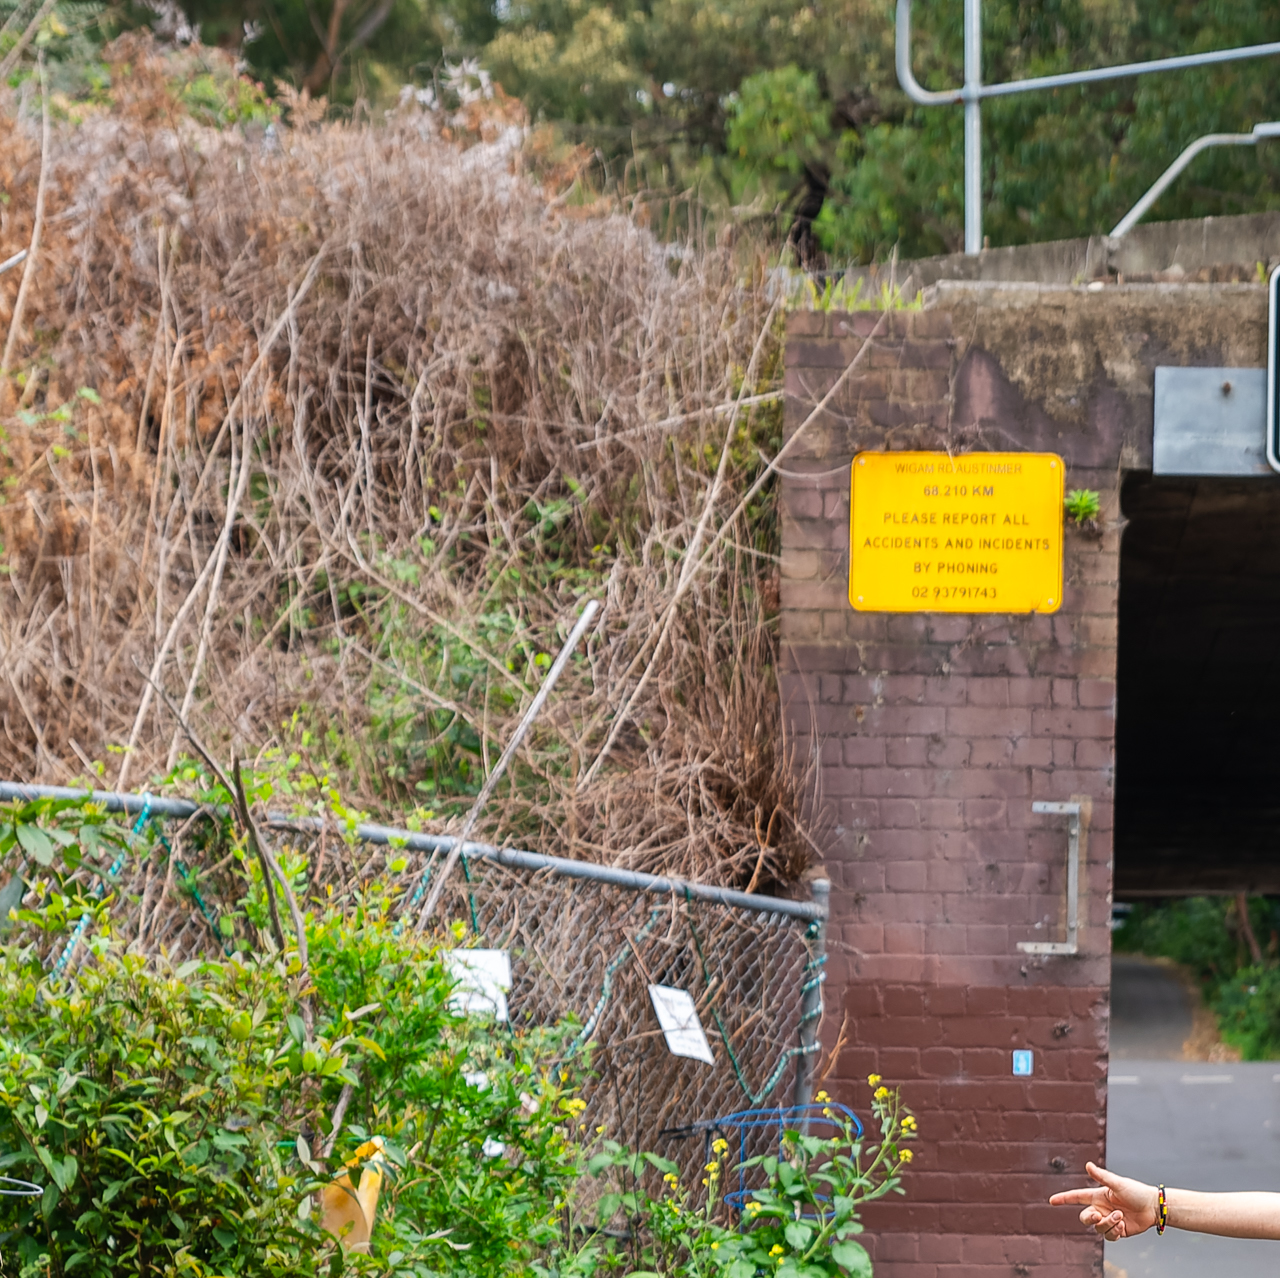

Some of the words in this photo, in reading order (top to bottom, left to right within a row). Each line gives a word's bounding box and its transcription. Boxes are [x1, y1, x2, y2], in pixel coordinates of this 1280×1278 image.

[956, 464, 1022, 474] AUSTINMER
[972, 486, 994, 496] KM
[883, 512, 937, 524] PLEASE
[943, 513, 997, 525] REPORT
[1003, 514, 1030, 526] ALL
[863, 537, 939, 549] ACCIDENTS
[944, 538, 974, 549] AND
[978, 539, 1050, 550] INCIDENTS
[913, 562, 932, 574] BY
[937, 562, 999, 574] PHONING
[911, 586, 928, 598] 02
[933, 586, 997, 599] 93791743
